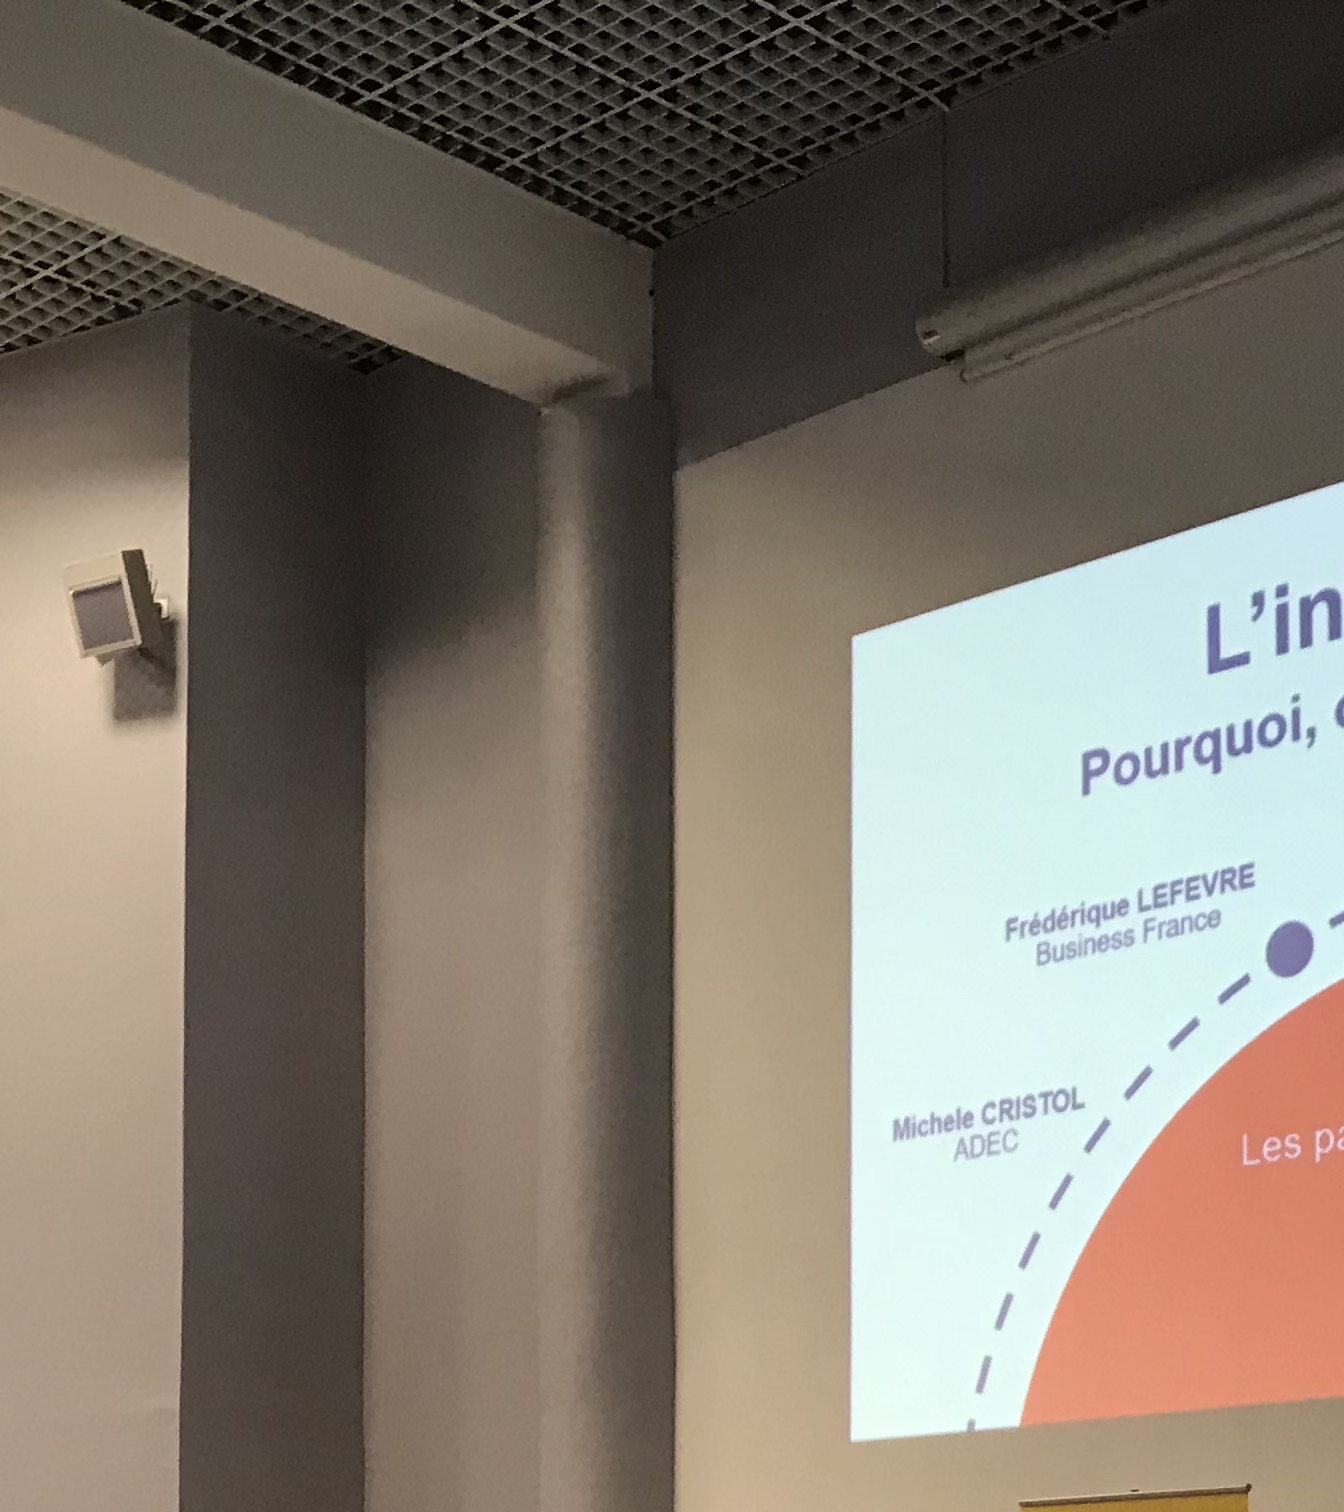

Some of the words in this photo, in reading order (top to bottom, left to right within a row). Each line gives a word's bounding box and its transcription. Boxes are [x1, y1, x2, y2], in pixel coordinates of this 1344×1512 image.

[1081, 695, 1317, 797] Pourquoi,
[1005, 897, 1129, 943] Frédérique
[1138, 862, 1256, 913] LEFEVRE
[1036, 925, 1135, 966] Business
[1143, 908, 1222, 944] France
[892, 1106, 974, 1142] Michele
[981, 1087, 1085, 1126] CRISTOL
[953, 1128, 1019, 1163] ADEC
[1242, 1130, 1301, 1167] Les
